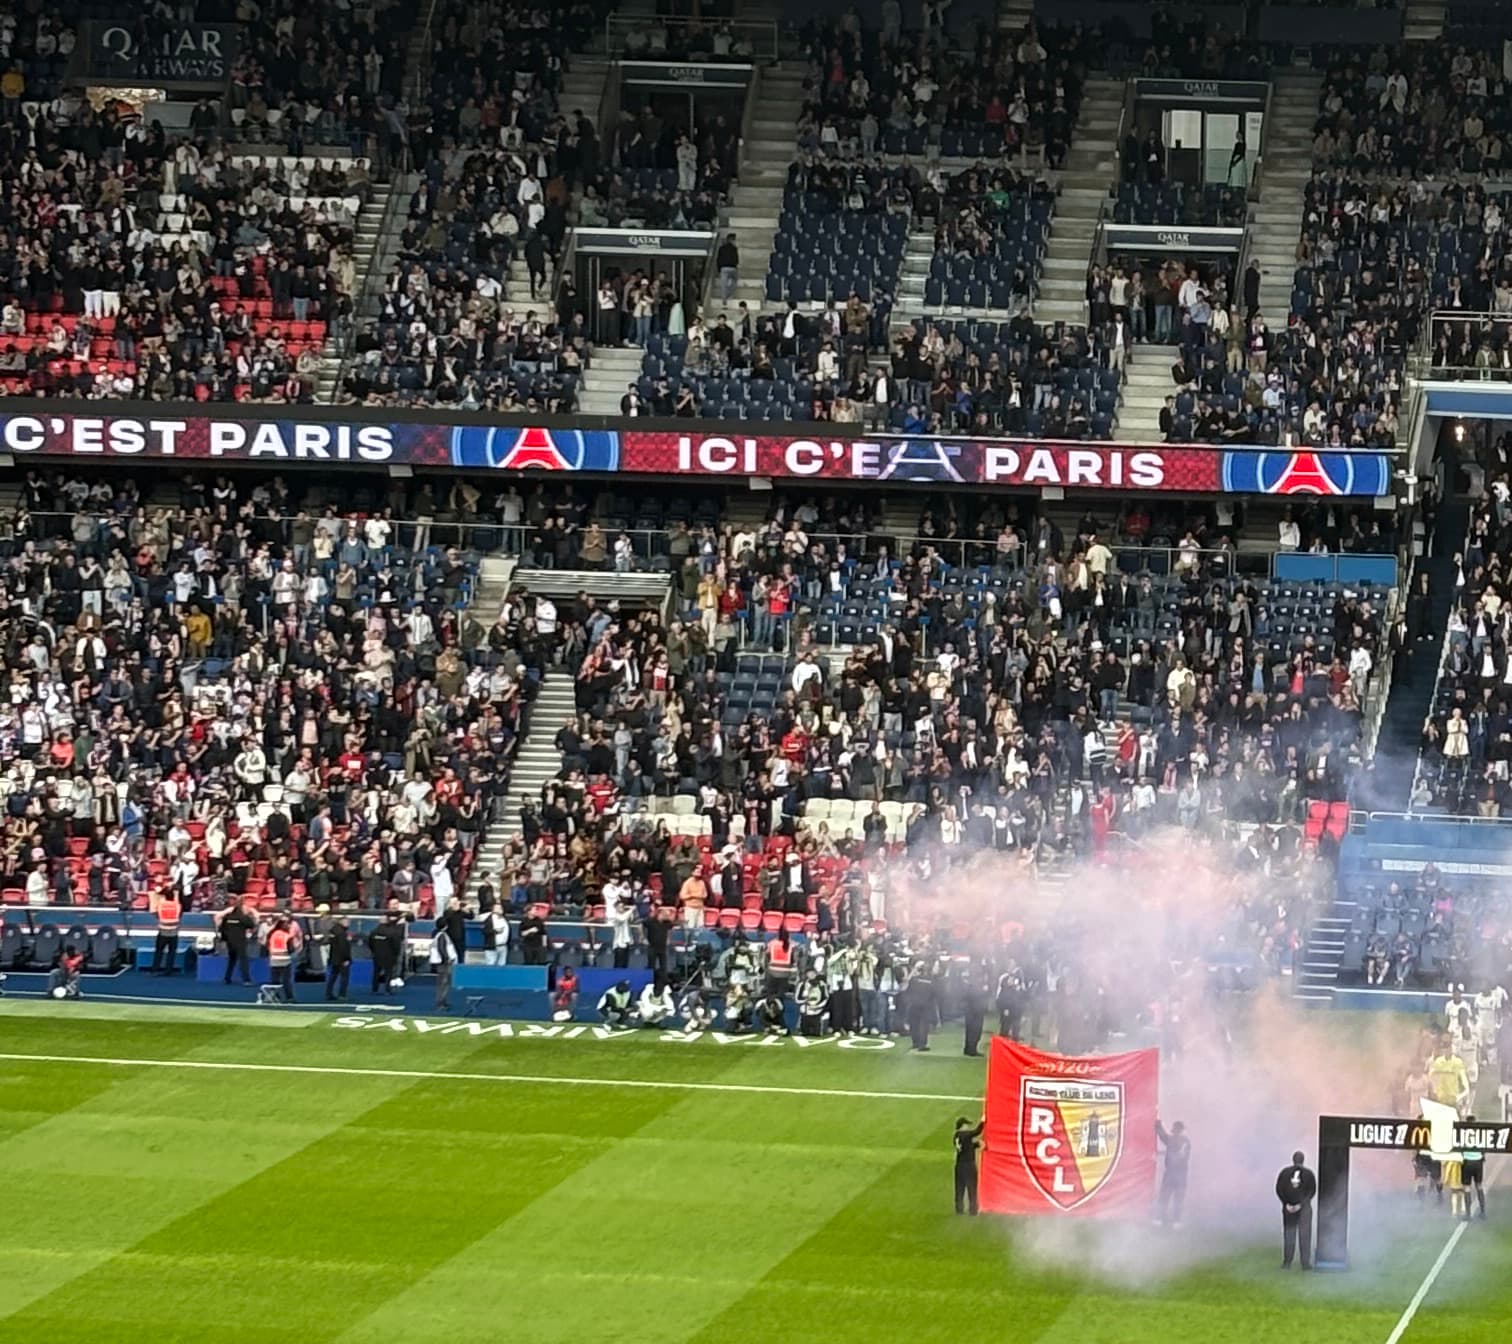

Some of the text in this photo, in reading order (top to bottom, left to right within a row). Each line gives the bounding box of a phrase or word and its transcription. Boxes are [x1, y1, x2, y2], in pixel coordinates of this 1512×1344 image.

[1184, 83, 1219, 92] QATAR
[4, 416, 393, 460] C'EST PARIS
[679, 437, 757, 473] ICI
[985, 448, 1164, 487] PARIS
[331, 1016, 638, 1040] AIRWAYS
[1350, 1123, 1393, 1144] LIGUE
[1453, 1127, 1494, 1148] LIGUE
